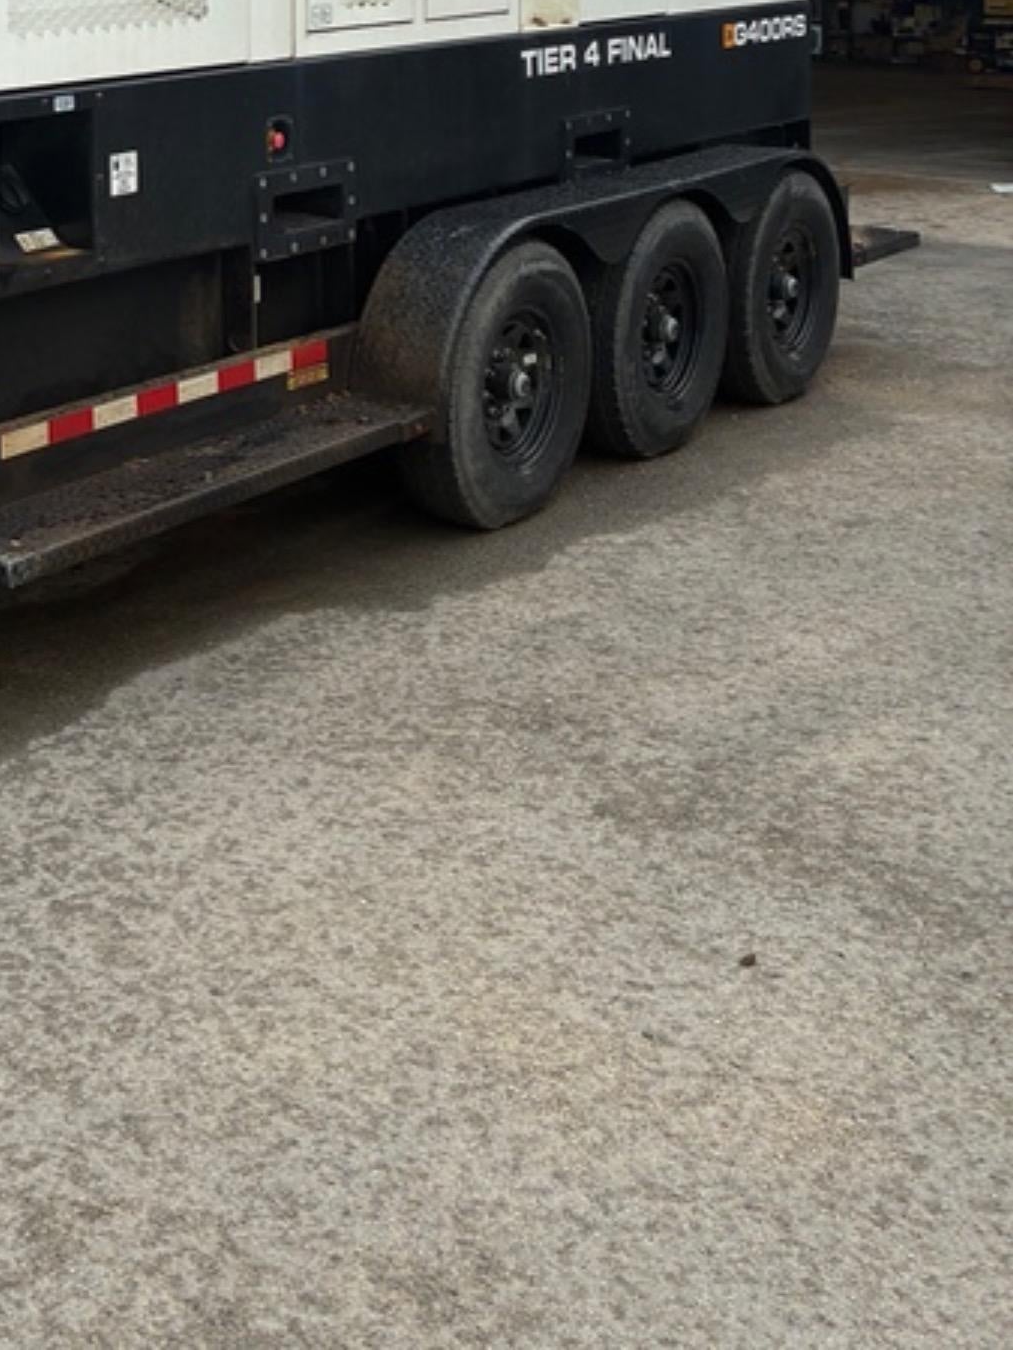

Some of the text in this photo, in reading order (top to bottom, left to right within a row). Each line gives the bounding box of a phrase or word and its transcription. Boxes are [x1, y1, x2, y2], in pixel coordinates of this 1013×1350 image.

[521, 32, 672, 79] TIER 4 FINAL
